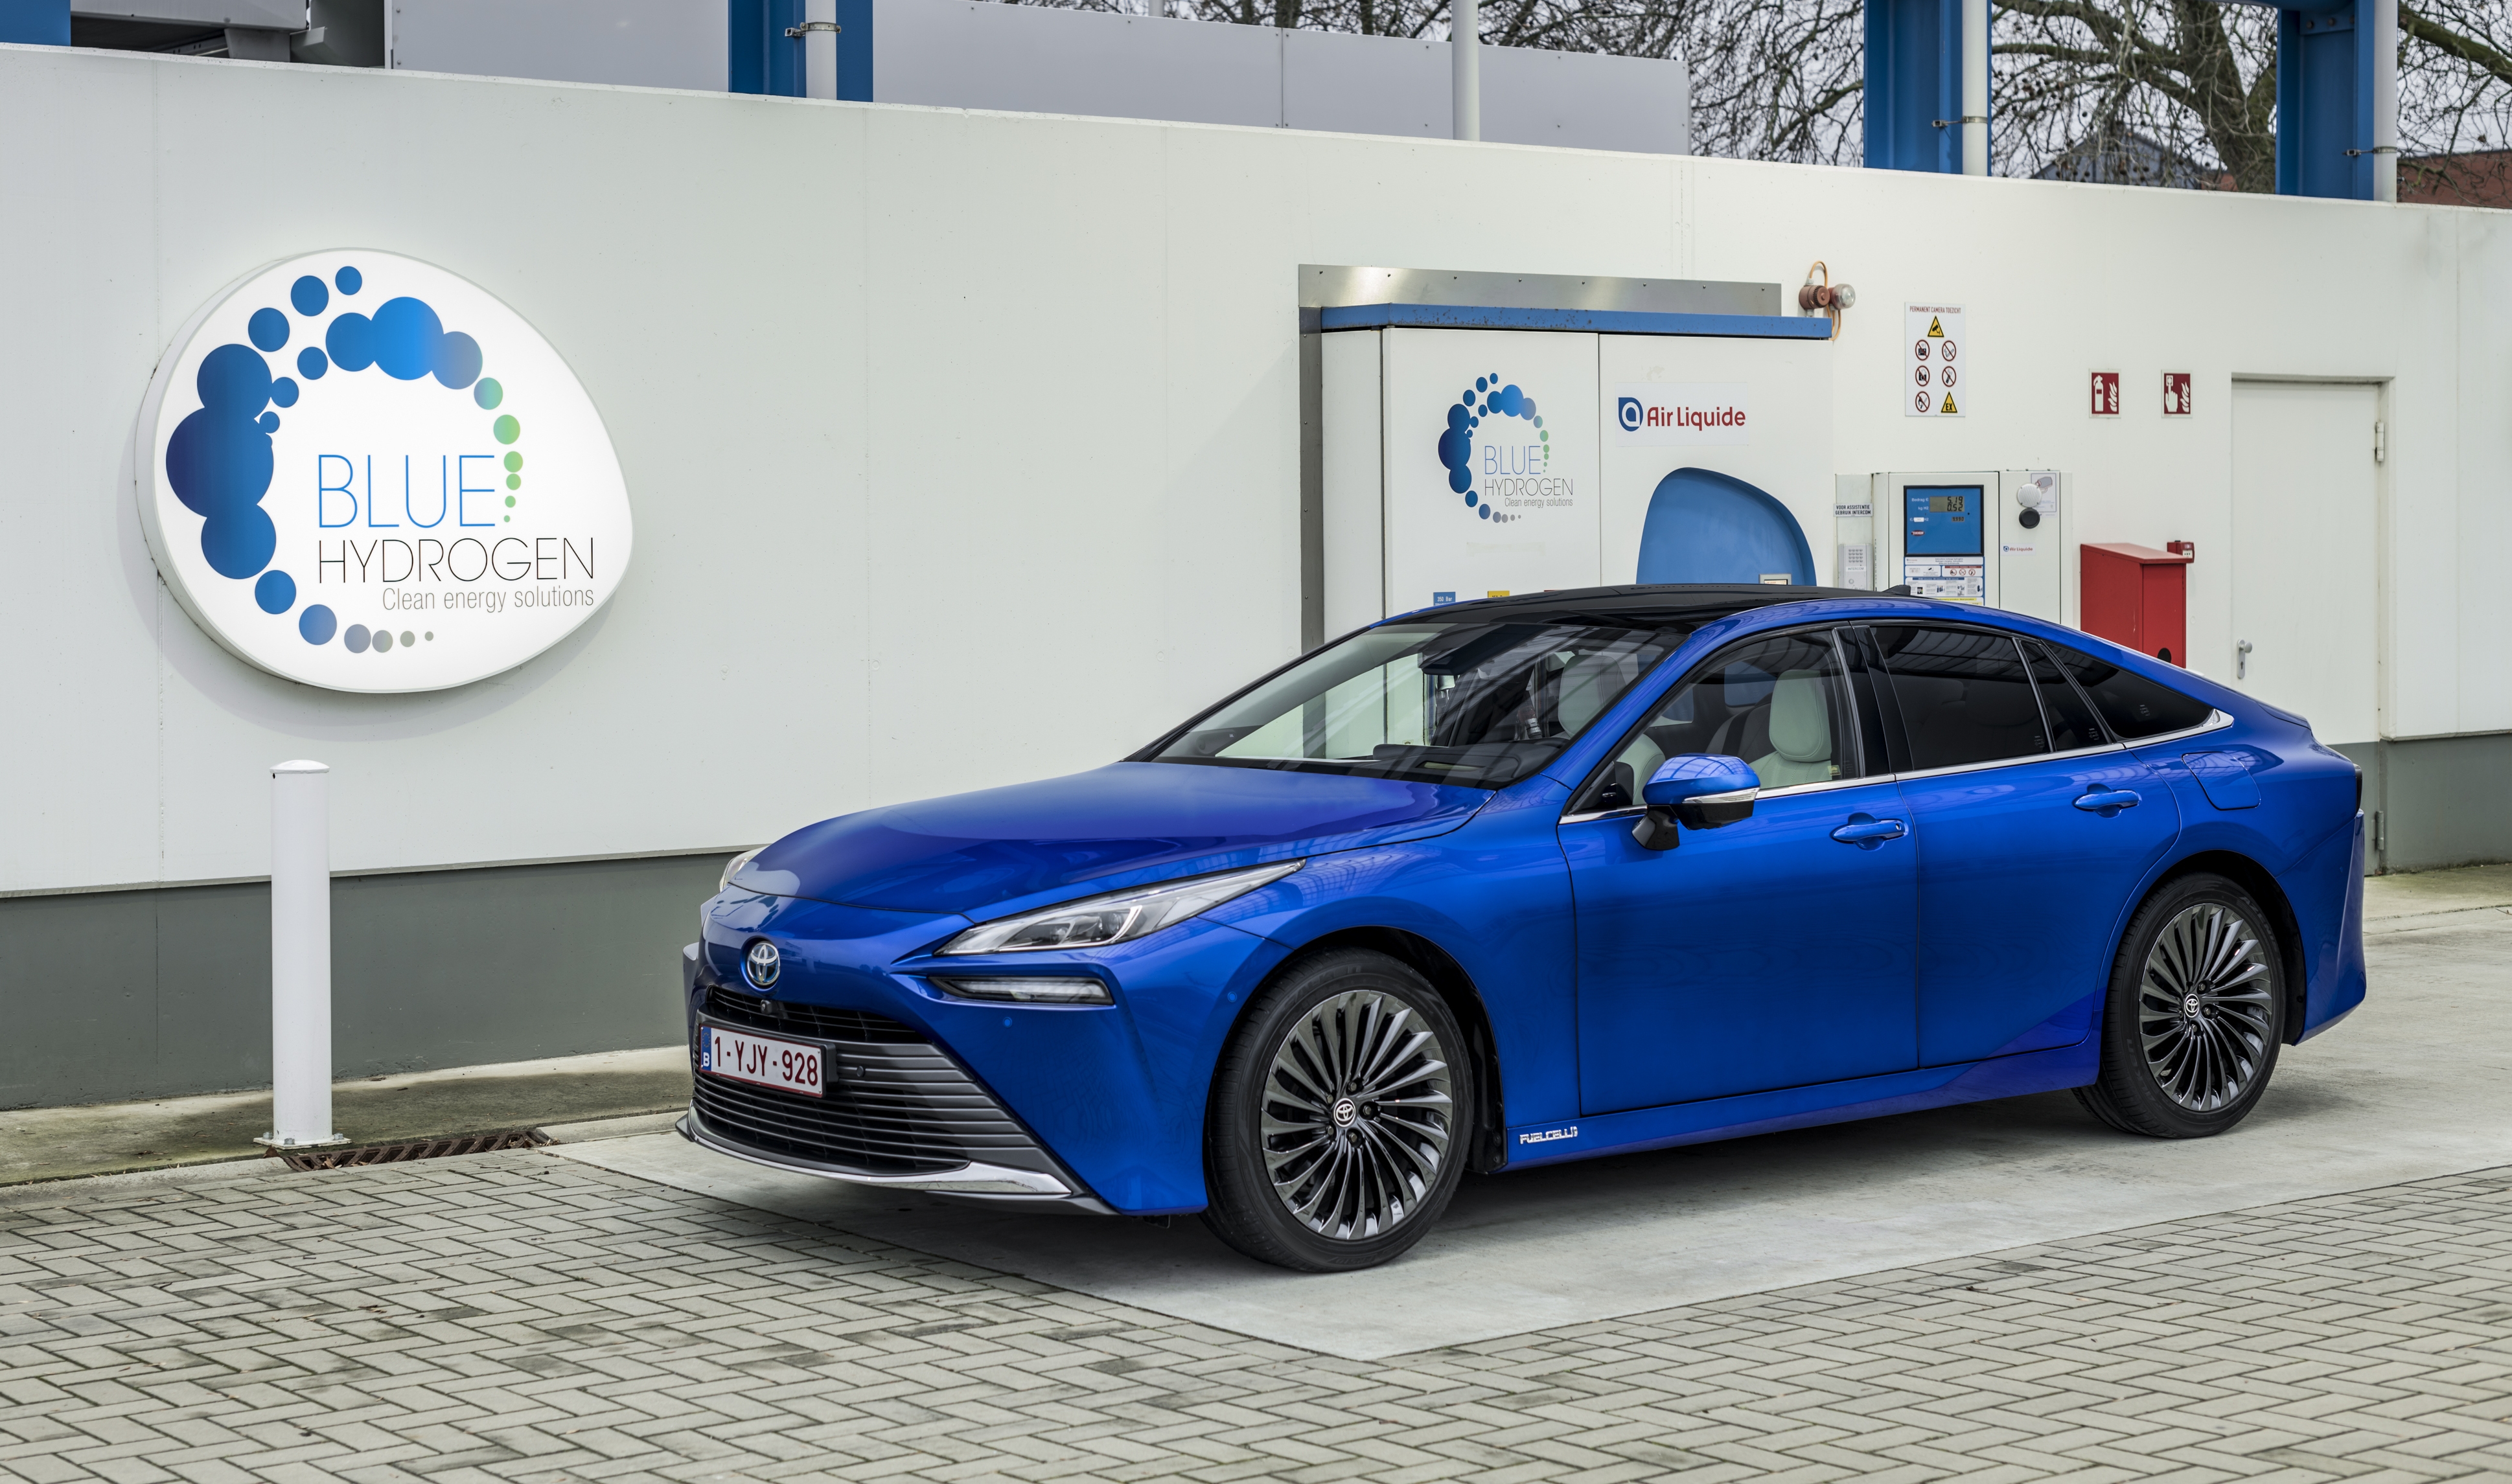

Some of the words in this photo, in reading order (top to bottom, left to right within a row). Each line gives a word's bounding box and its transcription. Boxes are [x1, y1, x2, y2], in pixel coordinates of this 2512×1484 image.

[1647, 406, 1673, 427] Air
[1677, 406, 1746, 431] Liquide
[1945, 403, 1953, 411] EX
[1484, 446, 1541, 475] BLUE
[318, 454, 496, 528] BLUE
[1484, 478, 1573, 496] HYDROGEN
[1504, 497, 1522, 507] Clean
[1523, 499, 1545, 509] energy
[1546, 497, 1573, 507] solutions
[319, 537, 594, 584] HYDROGEN
[382, 587, 435, 610] Clean
[444, 591, 507, 613] energy
[514, 585, 594, 607] solutions
[703, 1051, 710, 1067] B
[715, 1036, 818, 1086] 1-YJY-928
